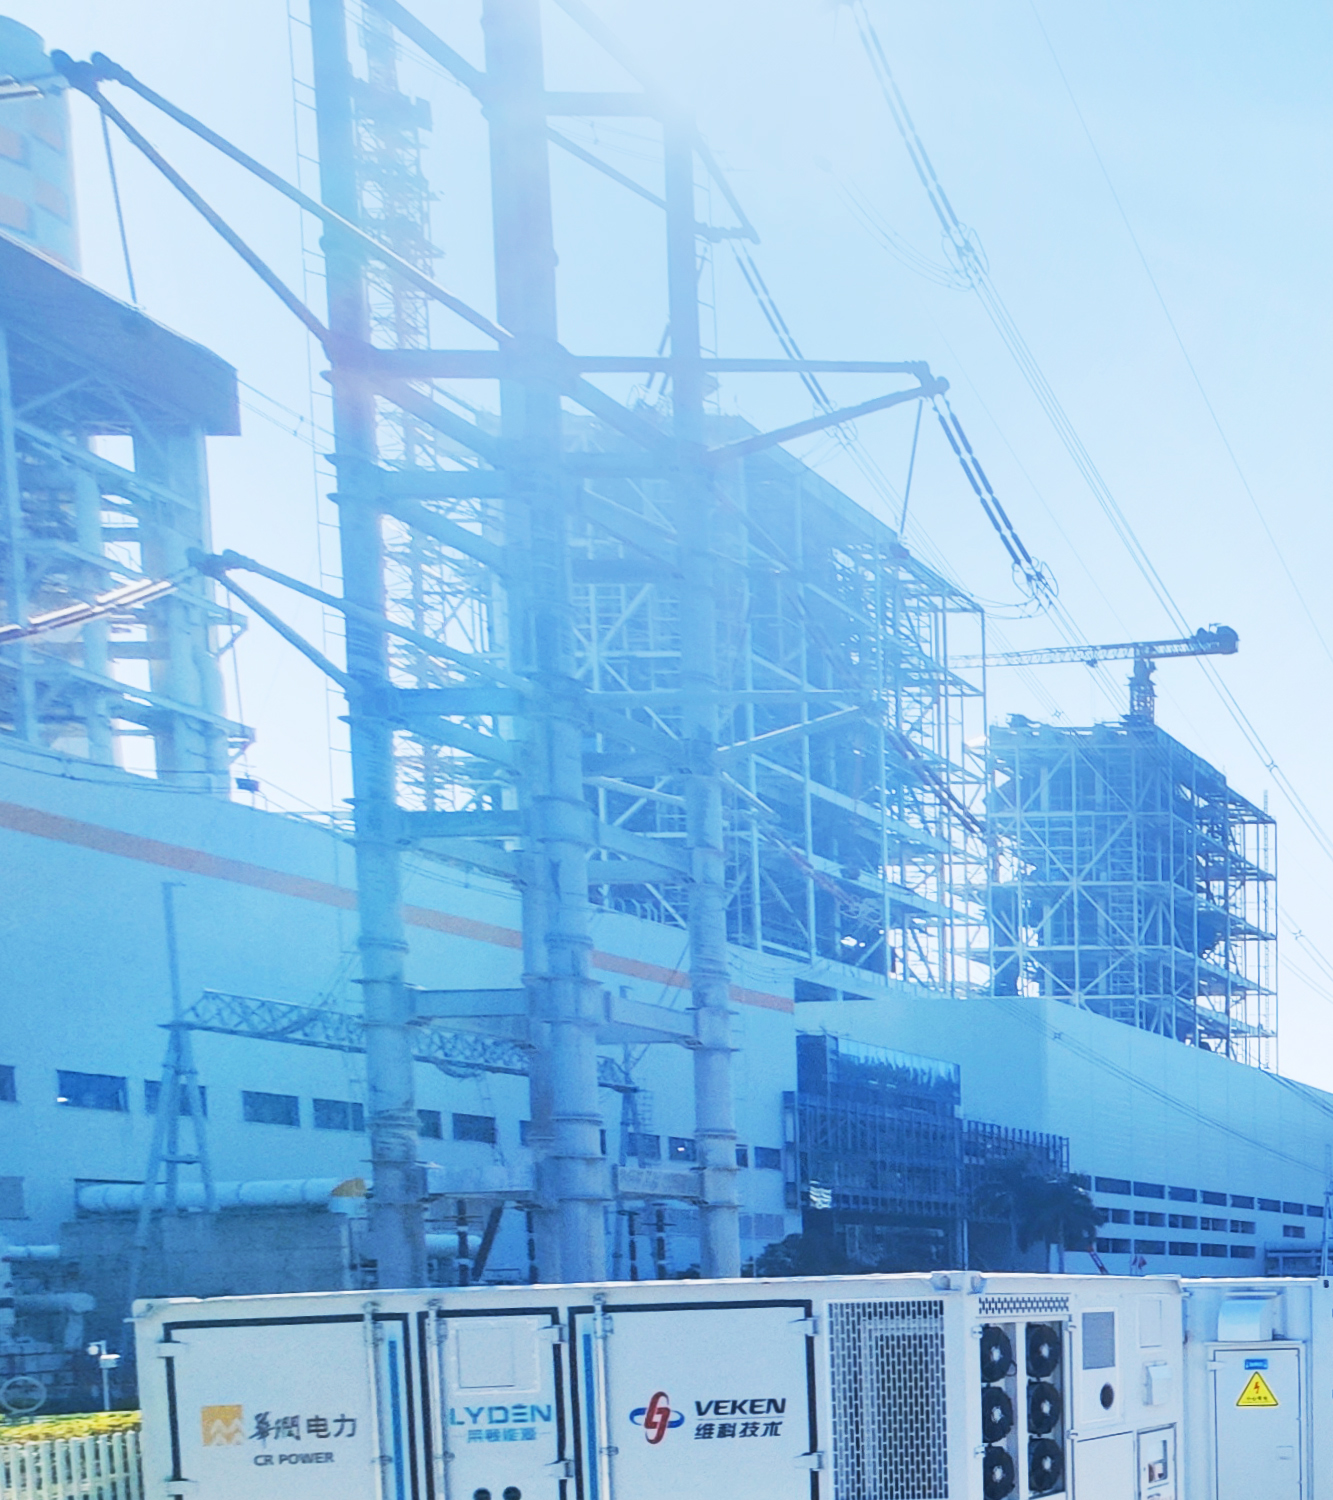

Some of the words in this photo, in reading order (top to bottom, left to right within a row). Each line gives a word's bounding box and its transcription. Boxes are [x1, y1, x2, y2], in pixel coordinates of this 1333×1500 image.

[449, 1404, 551, 1426] LYDEN
[695, 1398, 786, 1416] VEKEN
[694, 1421, 783, 1440] 维科技术
[254, 1454, 275, 1467] CR
[279, 1452, 335, 1465] POWER
